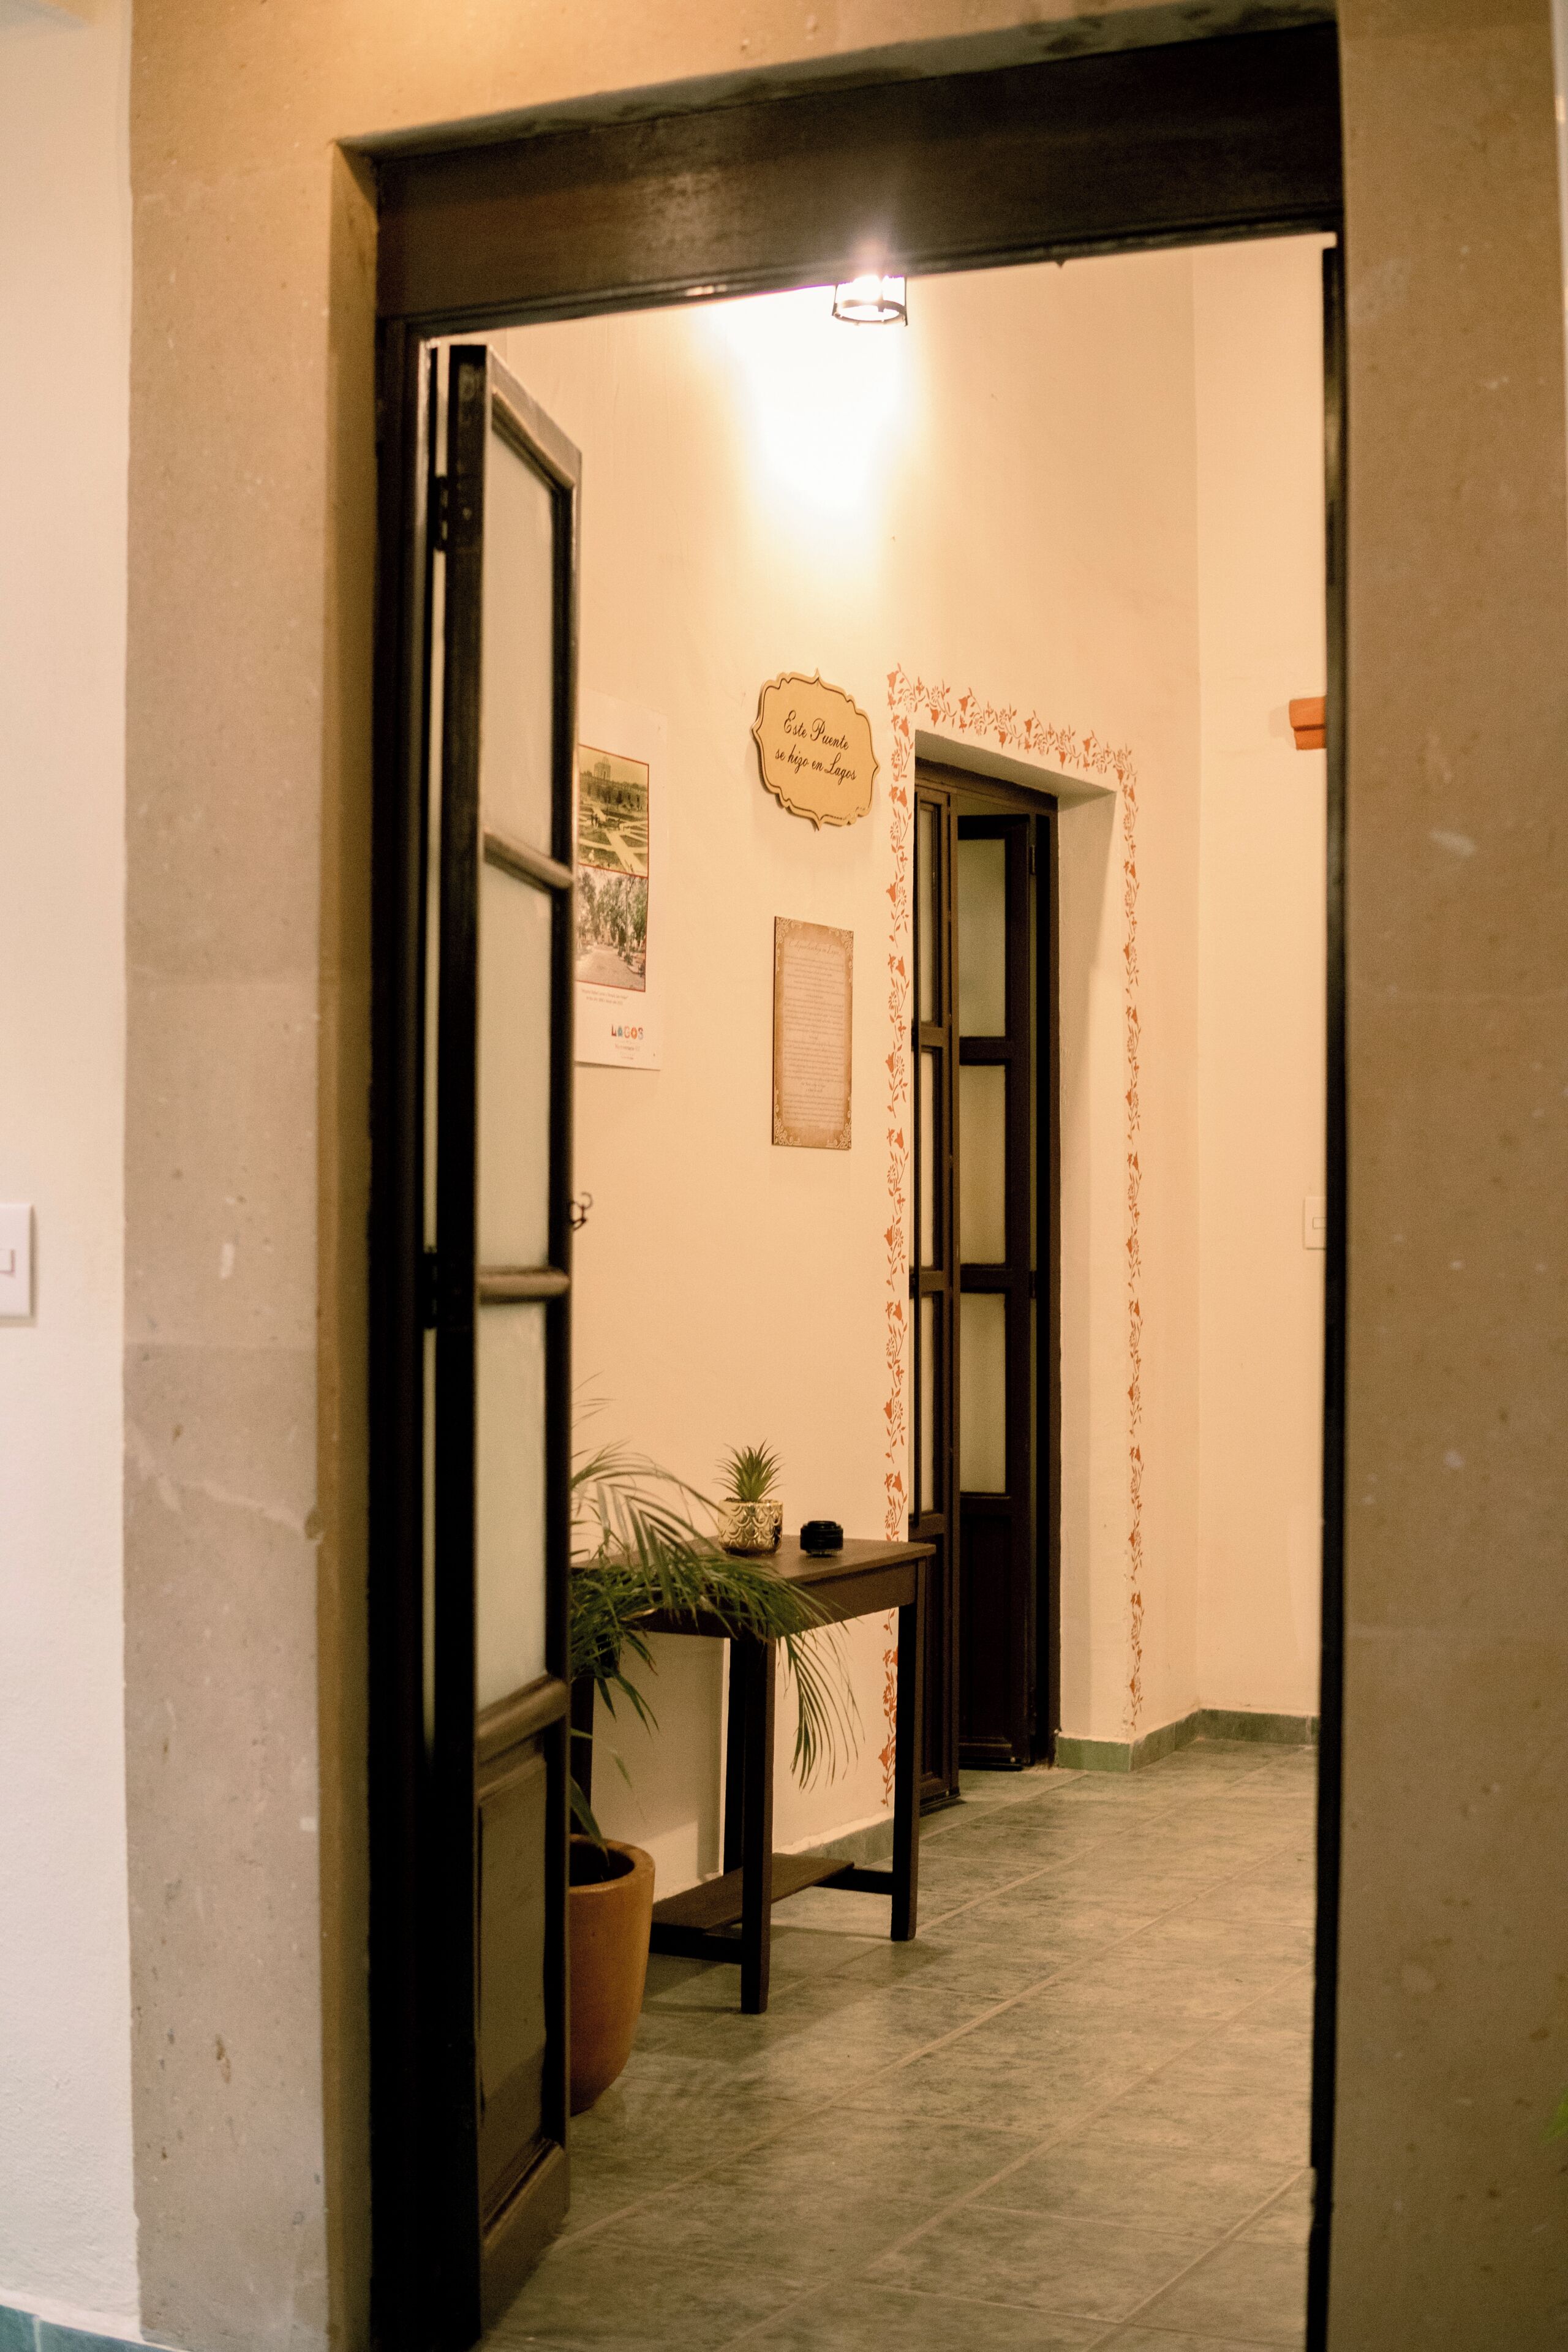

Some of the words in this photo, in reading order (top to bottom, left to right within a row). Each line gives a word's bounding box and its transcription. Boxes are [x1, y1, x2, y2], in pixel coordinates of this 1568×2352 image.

[784, 710, 807, 739] Este
[810, 718, 849, 750] Puente
[775, 748, 785, 760] se
[788, 744, 809, 774] hizo
[812, 760, 823, 772] en
[824, 752, 857, 785] Lagos
[611, 1025, 643, 1040] LAGOS
